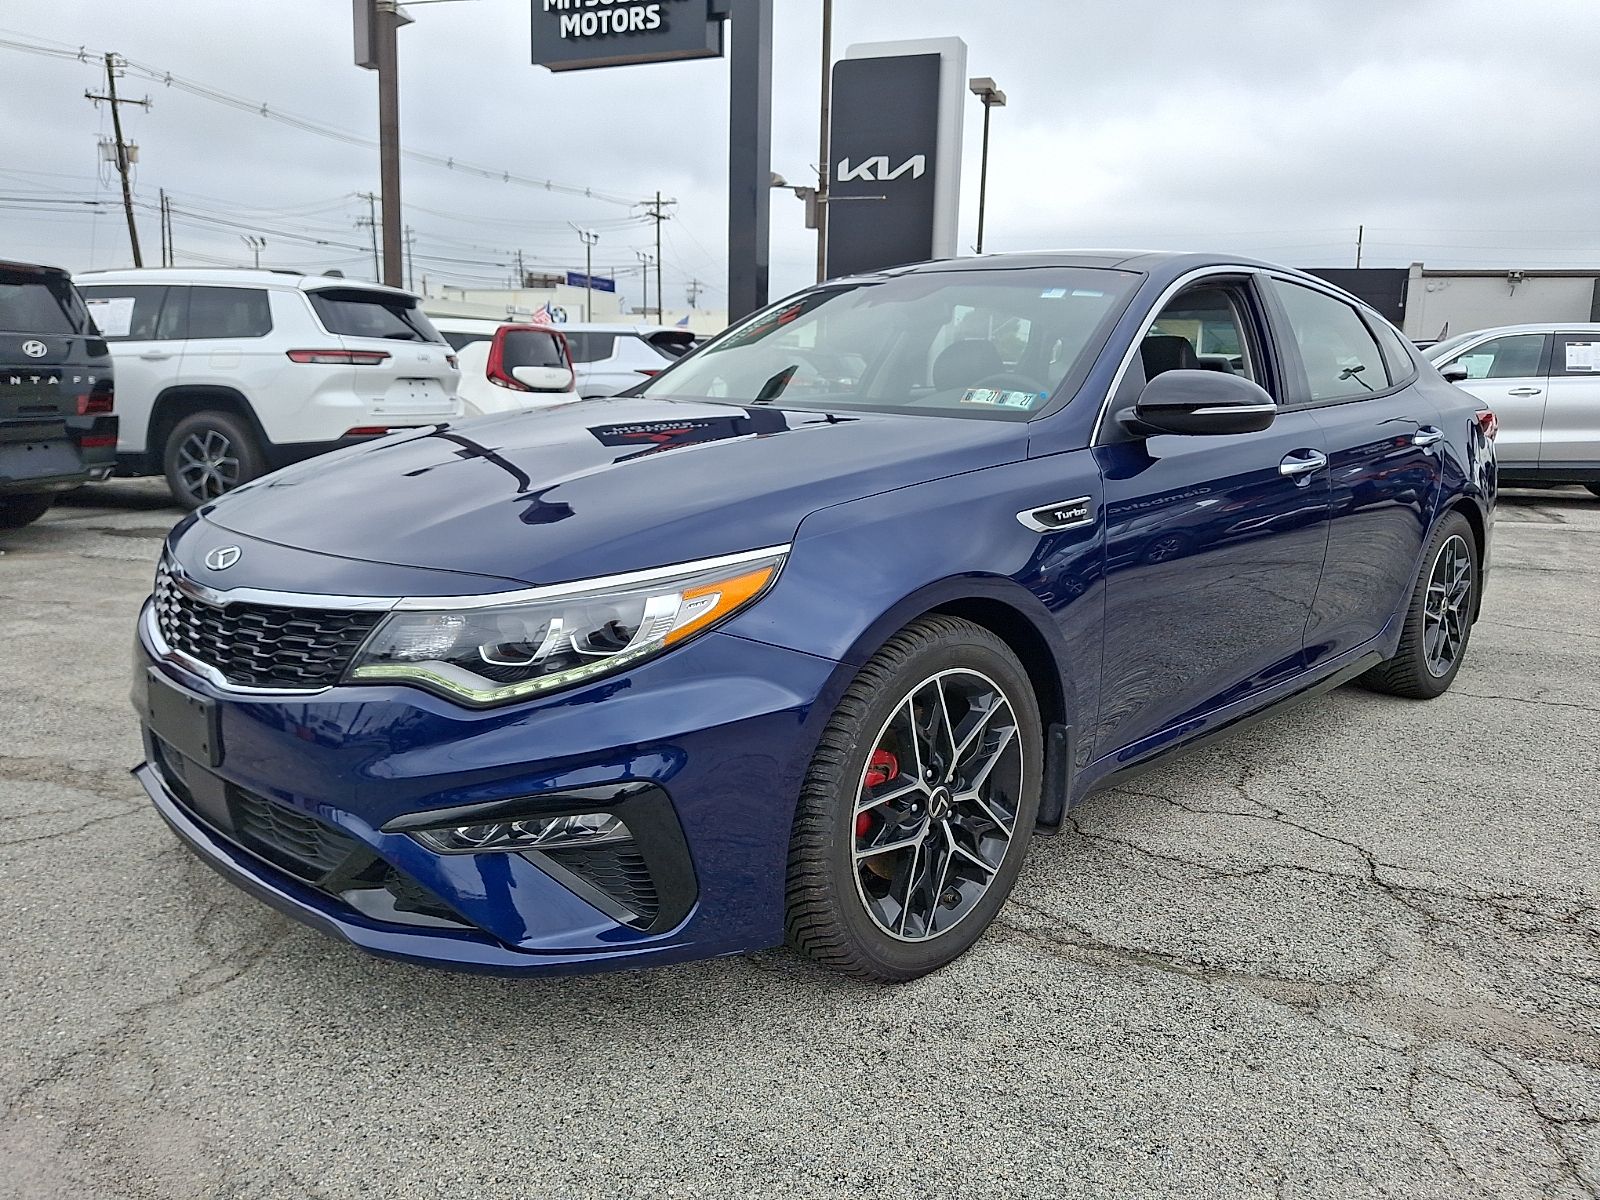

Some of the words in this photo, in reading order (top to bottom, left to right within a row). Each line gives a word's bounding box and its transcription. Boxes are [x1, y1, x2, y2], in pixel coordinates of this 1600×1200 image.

[560, 4, 661, 38] MOTORS
[838, 154, 926, 183] KIA
[986, 391, 998, 402] 27
[1020, 395, 1032, 407] 27
[1054, 508, 1088, 521] Turbo
